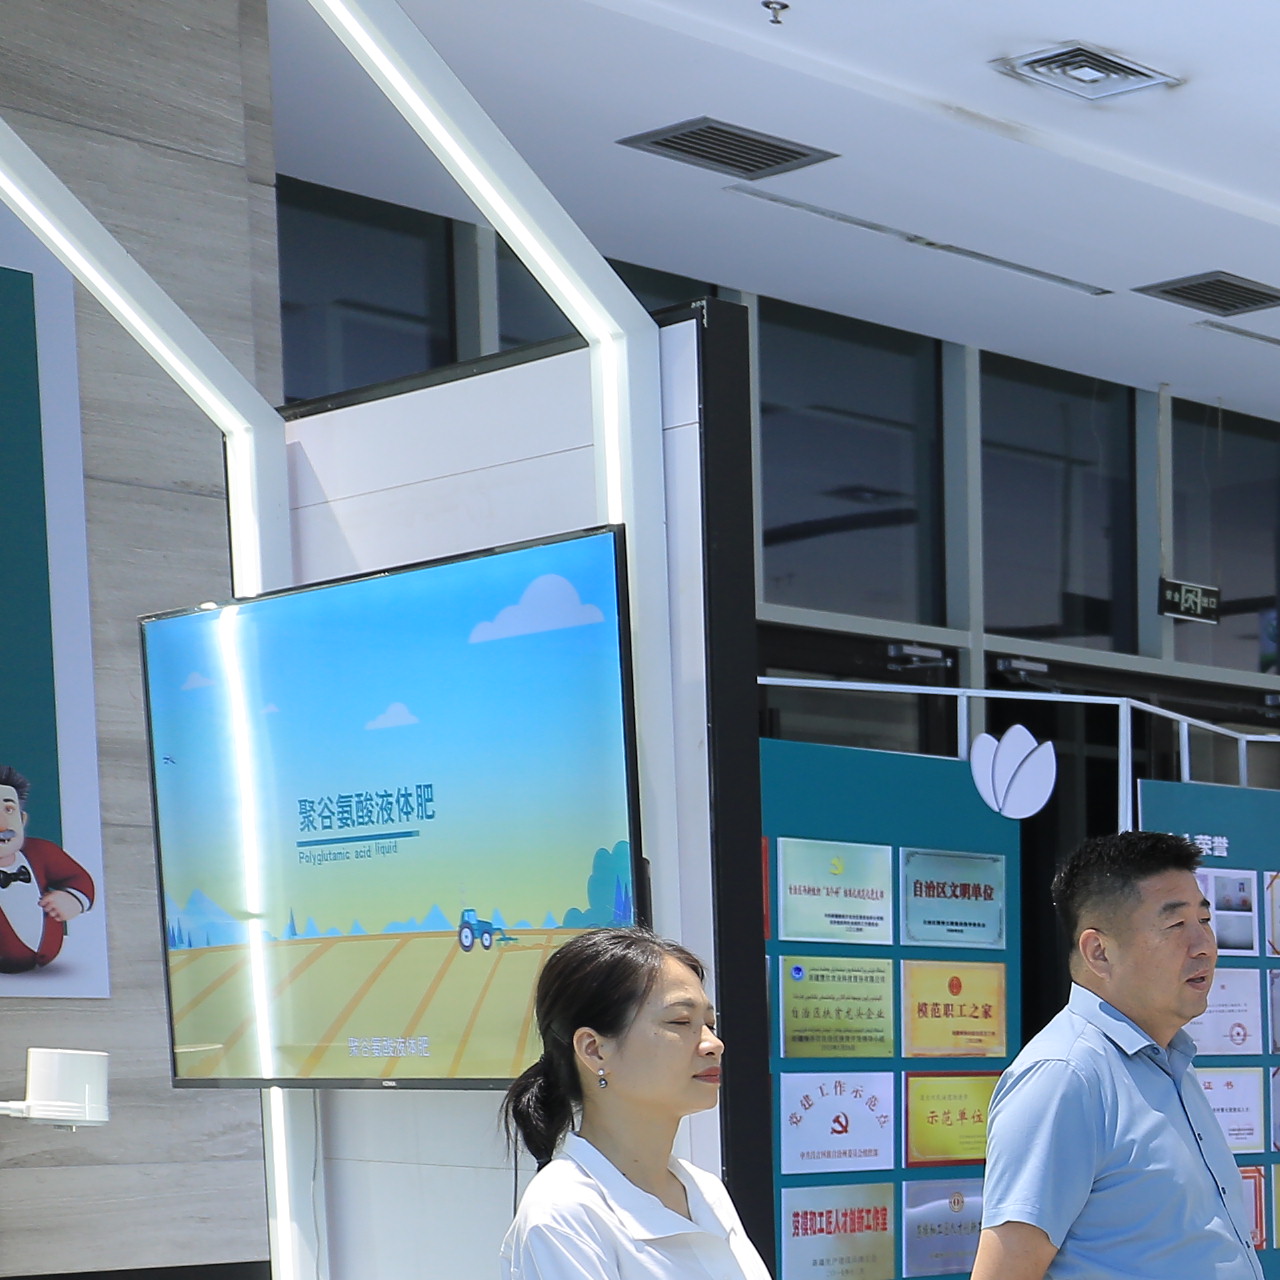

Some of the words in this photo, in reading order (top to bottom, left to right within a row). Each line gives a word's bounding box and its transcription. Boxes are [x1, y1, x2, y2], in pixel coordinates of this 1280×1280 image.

[298, 783, 436, 833] 聚谷氨酸液体肥
[299, 846, 350, 865] Polyglutamic
[355, 845, 372, 859] acid
[375, 840, 398, 855] liquid
[913, 879, 994, 901] 自治区文明单位
[917, 1002, 993, 1019] 模范职工之家
[348, 1037, 430, 1057] 聚谷氨酸液体肥
[788, 1080, 889, 1128] 党建工作示范点
[926, 1107, 985, 1127] 示范单位
[792, 1205, 888, 1238] 劳模和工匠人才创新工作室
